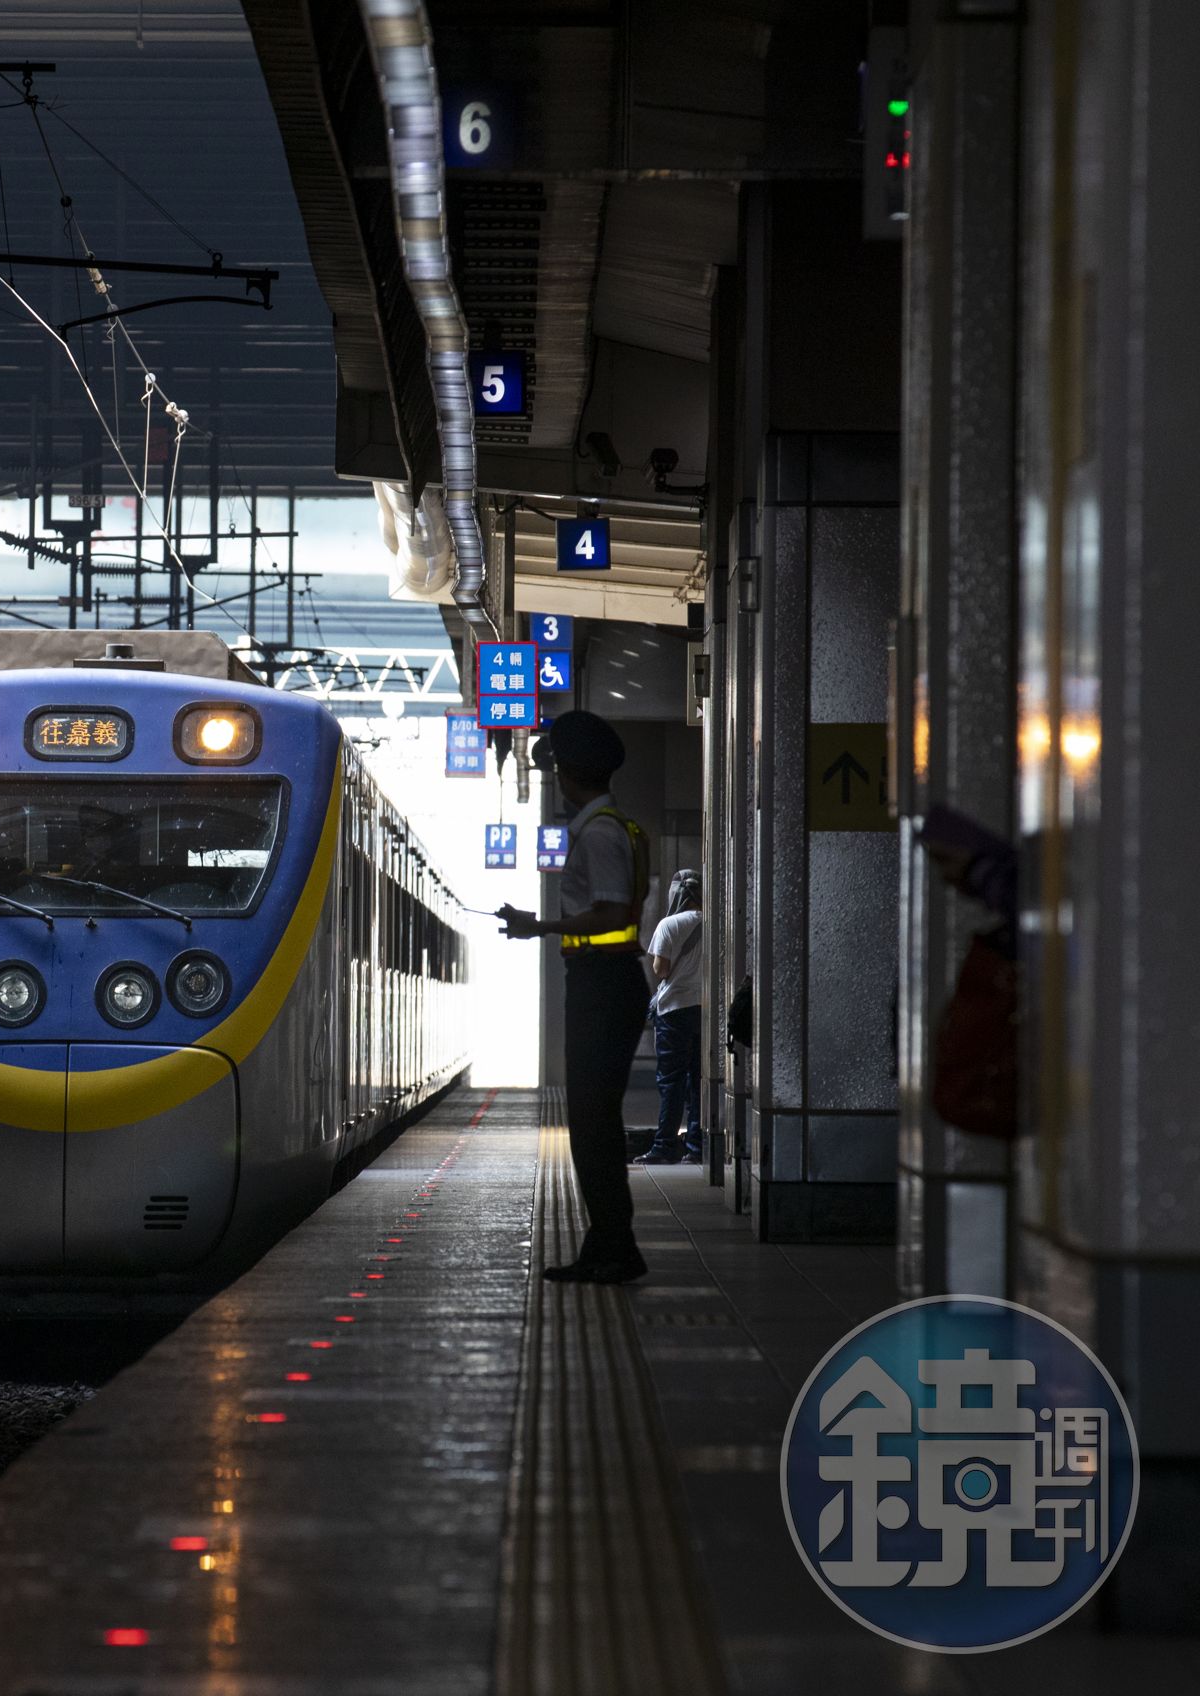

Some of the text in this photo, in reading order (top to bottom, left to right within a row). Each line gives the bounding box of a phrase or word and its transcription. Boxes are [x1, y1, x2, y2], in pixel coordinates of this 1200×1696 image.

[459, 101, 491, 154] 6
[481, 365, 505, 403] 5
[575, 529, 595, 560] 4
[543, 616, 559, 641] 3
[490, 673, 525, 690] 電車
[490, 702, 525, 720] 停車
[40, 718, 119, 746] 往嘉義
[490, 826, 512, 848] PP
[543, 828, 562, 850] 客
